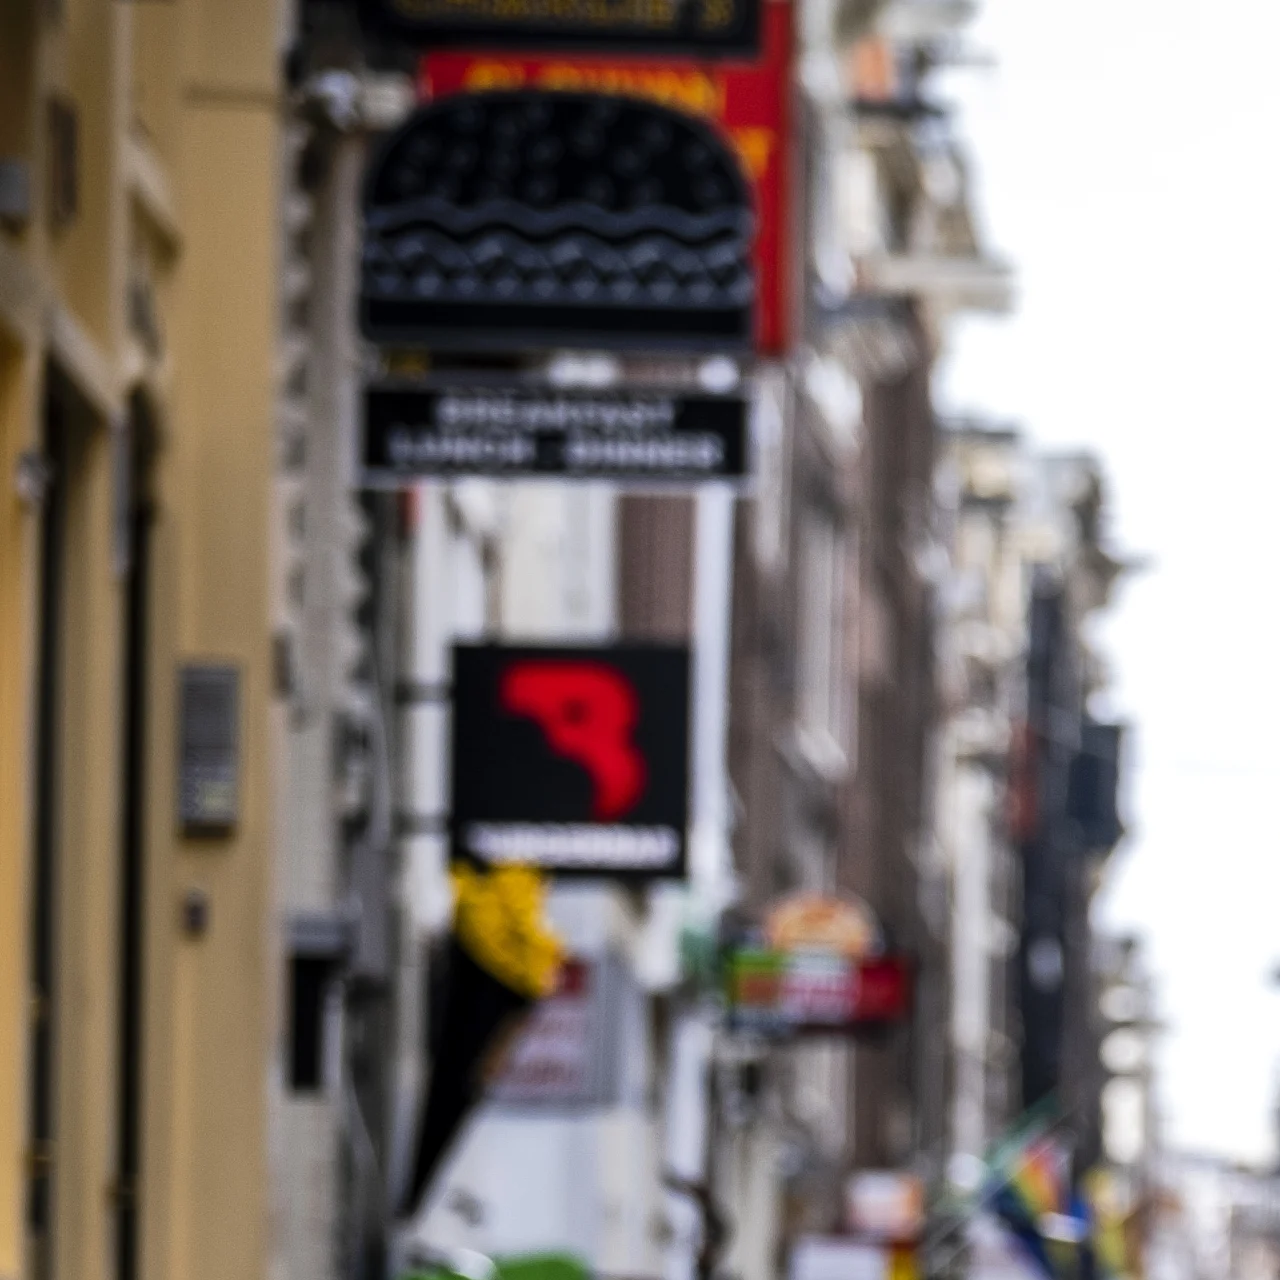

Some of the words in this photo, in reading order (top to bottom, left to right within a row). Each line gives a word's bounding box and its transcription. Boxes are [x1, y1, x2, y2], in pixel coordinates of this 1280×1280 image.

[436, 394, 679, 430] BREAKFAST
[390, 431, 533, 465] LUNCH
[564, 434, 724, 469] DINNER
